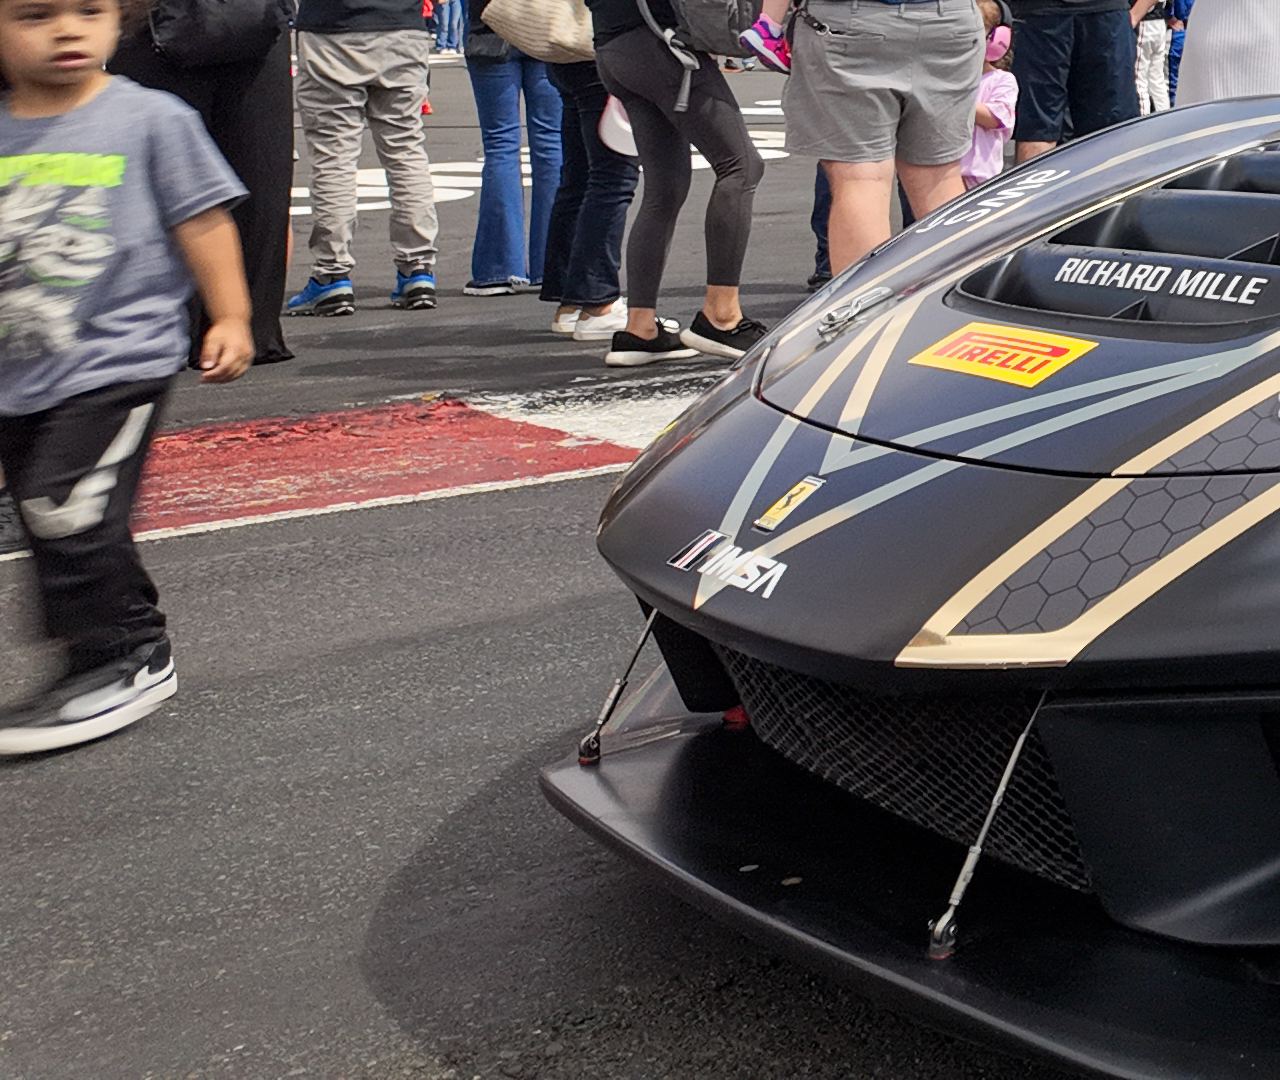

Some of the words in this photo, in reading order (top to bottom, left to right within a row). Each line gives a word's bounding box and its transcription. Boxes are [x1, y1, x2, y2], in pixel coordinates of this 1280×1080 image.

[1055, 257, 1172, 293] RICHARD
[1168, 269, 1269, 305] MILLE
[933, 331, 1071, 375] PIRELLI
[697, 544, 788, 599] IMSA
